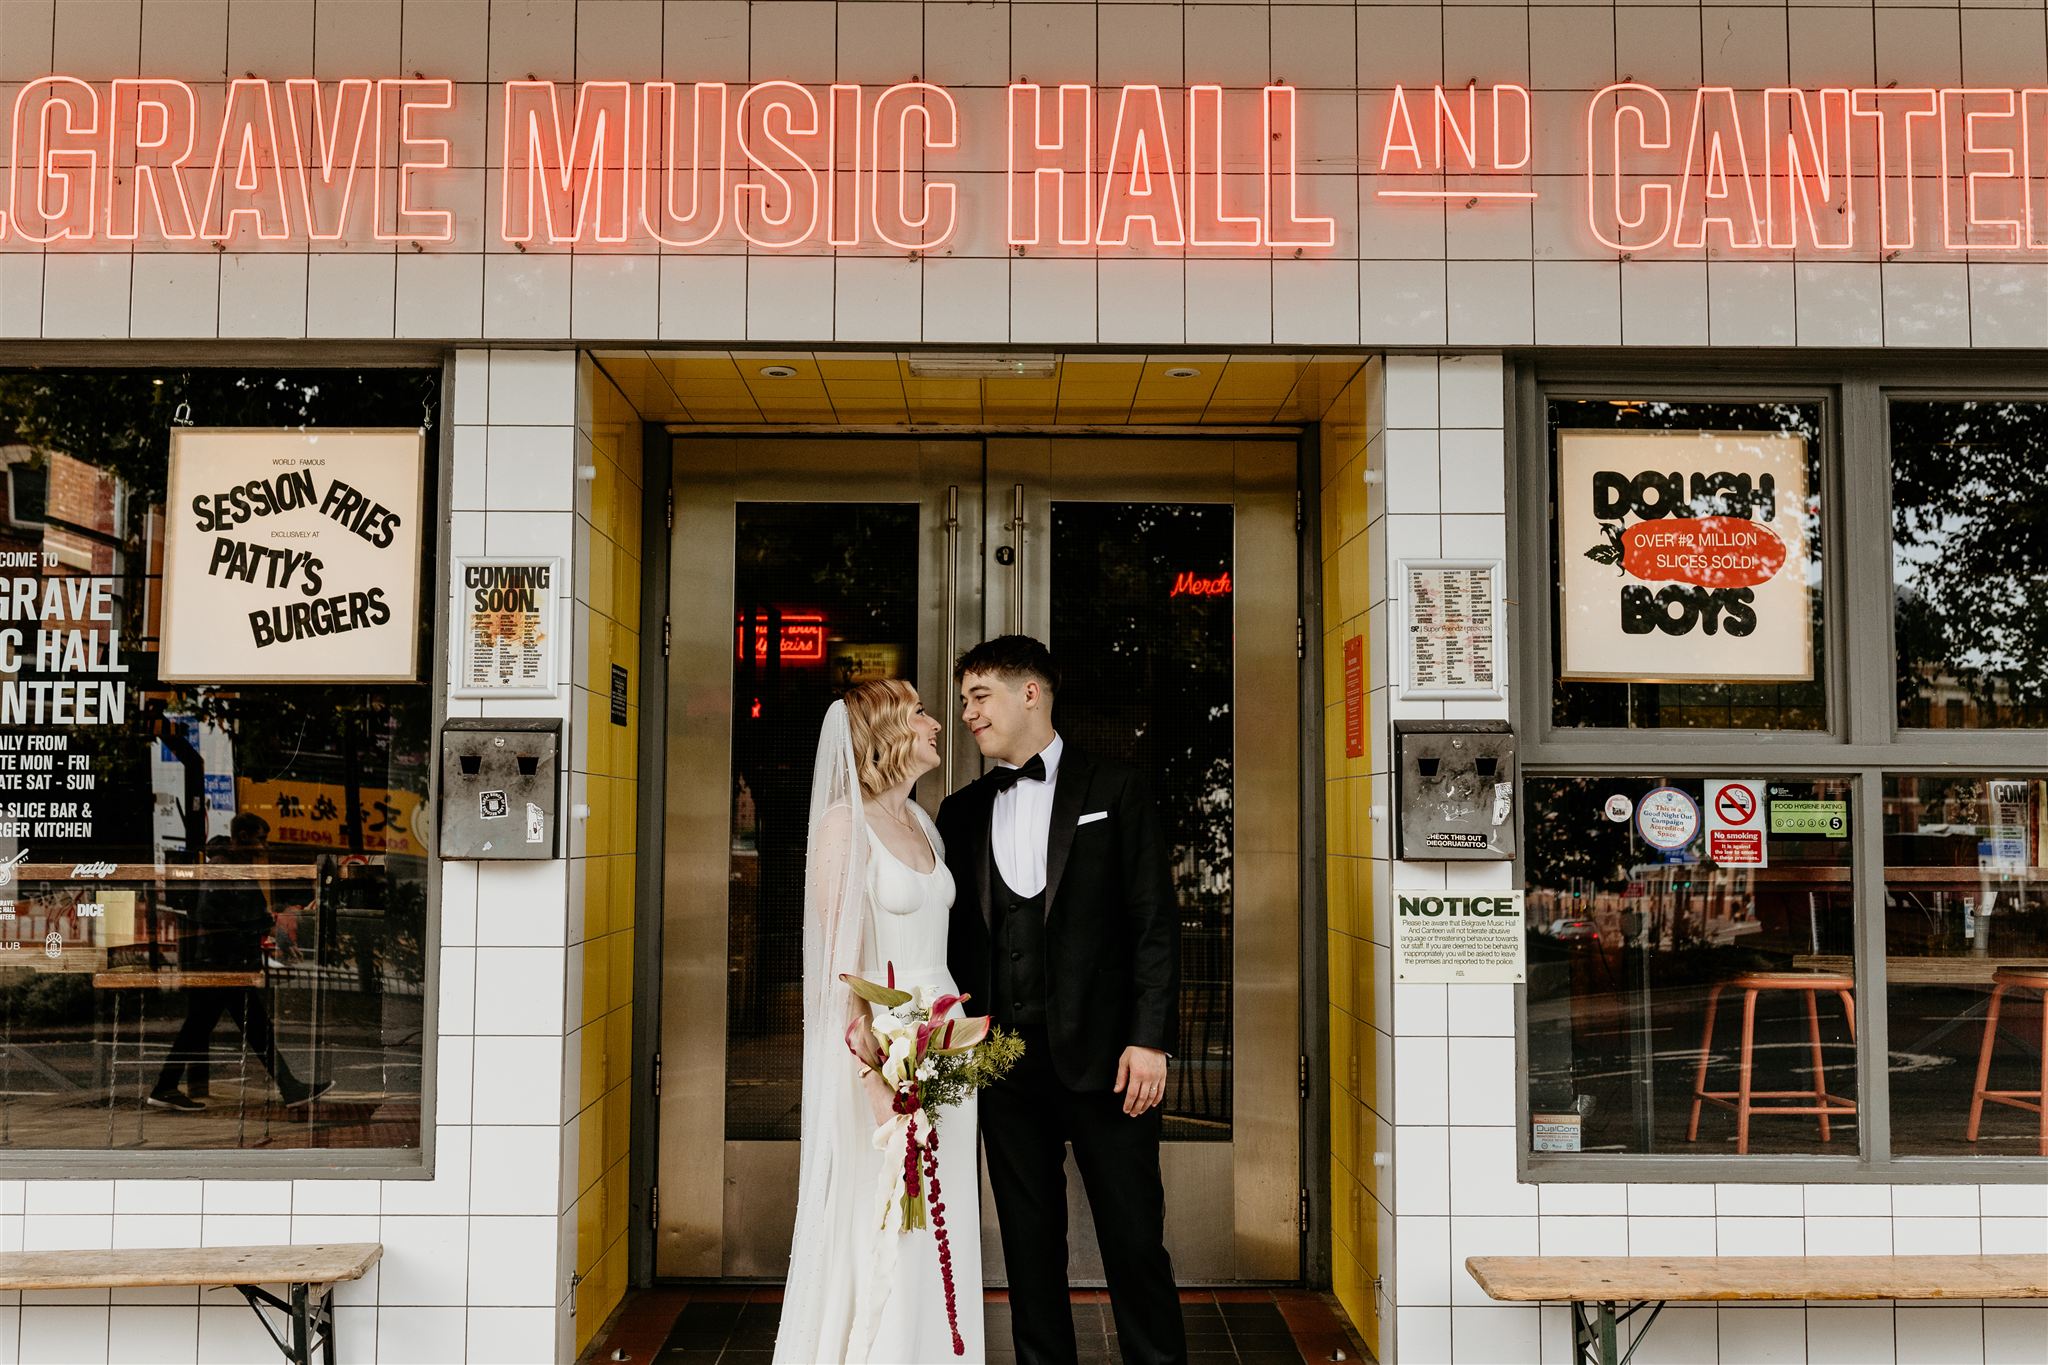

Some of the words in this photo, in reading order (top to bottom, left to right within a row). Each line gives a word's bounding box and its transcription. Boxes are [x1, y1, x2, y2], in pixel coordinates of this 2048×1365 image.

[0, 76, 454, 243] GRAVE
[502, 79, 957, 247] MUSIC
[1007, 84, 1335, 247] HALL
[1380, 83, 1531, 171] AND
[272, 458, 295, 466] WORLD
[299, 458, 325, 466] FAMOUS
[1593, 470, 1776, 523] DOUGH
[192, 468, 318, 532] SESSION
[318, 479, 401, 549] FRIES
[1634, 533, 1674, 547] OVER
[1698, 532, 1757, 547] MILLION
[0, 552, 37, 568] COME
[41, 552, 59, 568] TO
[208, 536, 324, 597] PATTY'S
[1656, 553, 1708, 569] SLICES
[1711, 554, 1755, 569] SOLD!
[465, 567, 550, 589] COMING
[1170, 571, 1233, 598] Merch
[474, 588, 540, 613] SOON.
[248, 587, 391, 649] BURGERS
[1621, 584, 1757, 638] BOYS
[36, 629, 129, 673] HALL
[0, 681, 126, 725] NTEEN
[27, 735, 67, 751] FROM
[0, 755, 18, 770] TE
[20, 755, 53, 770] MON
[68, 755, 90, 770] FRI
[26, 774, 52, 790] SAT
[66, 774, 95, 790] SUN
[7, 803, 46, 818] SLICE
[50, 803, 78, 818] BAR
[81, 803, 93, 818] &
[1651, 817, 1684, 826] Campaign
[1832, 818, 1840, 829] 5
[0, 822, 30, 838] GER
[34, 822, 92, 838] KITCHEN
[1726, 832, 1758, 840] smoking
[76, 903, 105, 917] DICE
[1399, 896, 1520, 917] NOTICE.
[1402, 919, 1421, 927] Please
[1423, 919, 1430, 927] be
[1431, 919, 1448, 927] aware
[1449, 919, 1460, 927] that
[1461, 919, 1486, 928] Belgrave
[1487, 919, 1504, 927] Music
[0, 942, 21, 950] LUB
[1492, 943, 1518, 951] behaving
